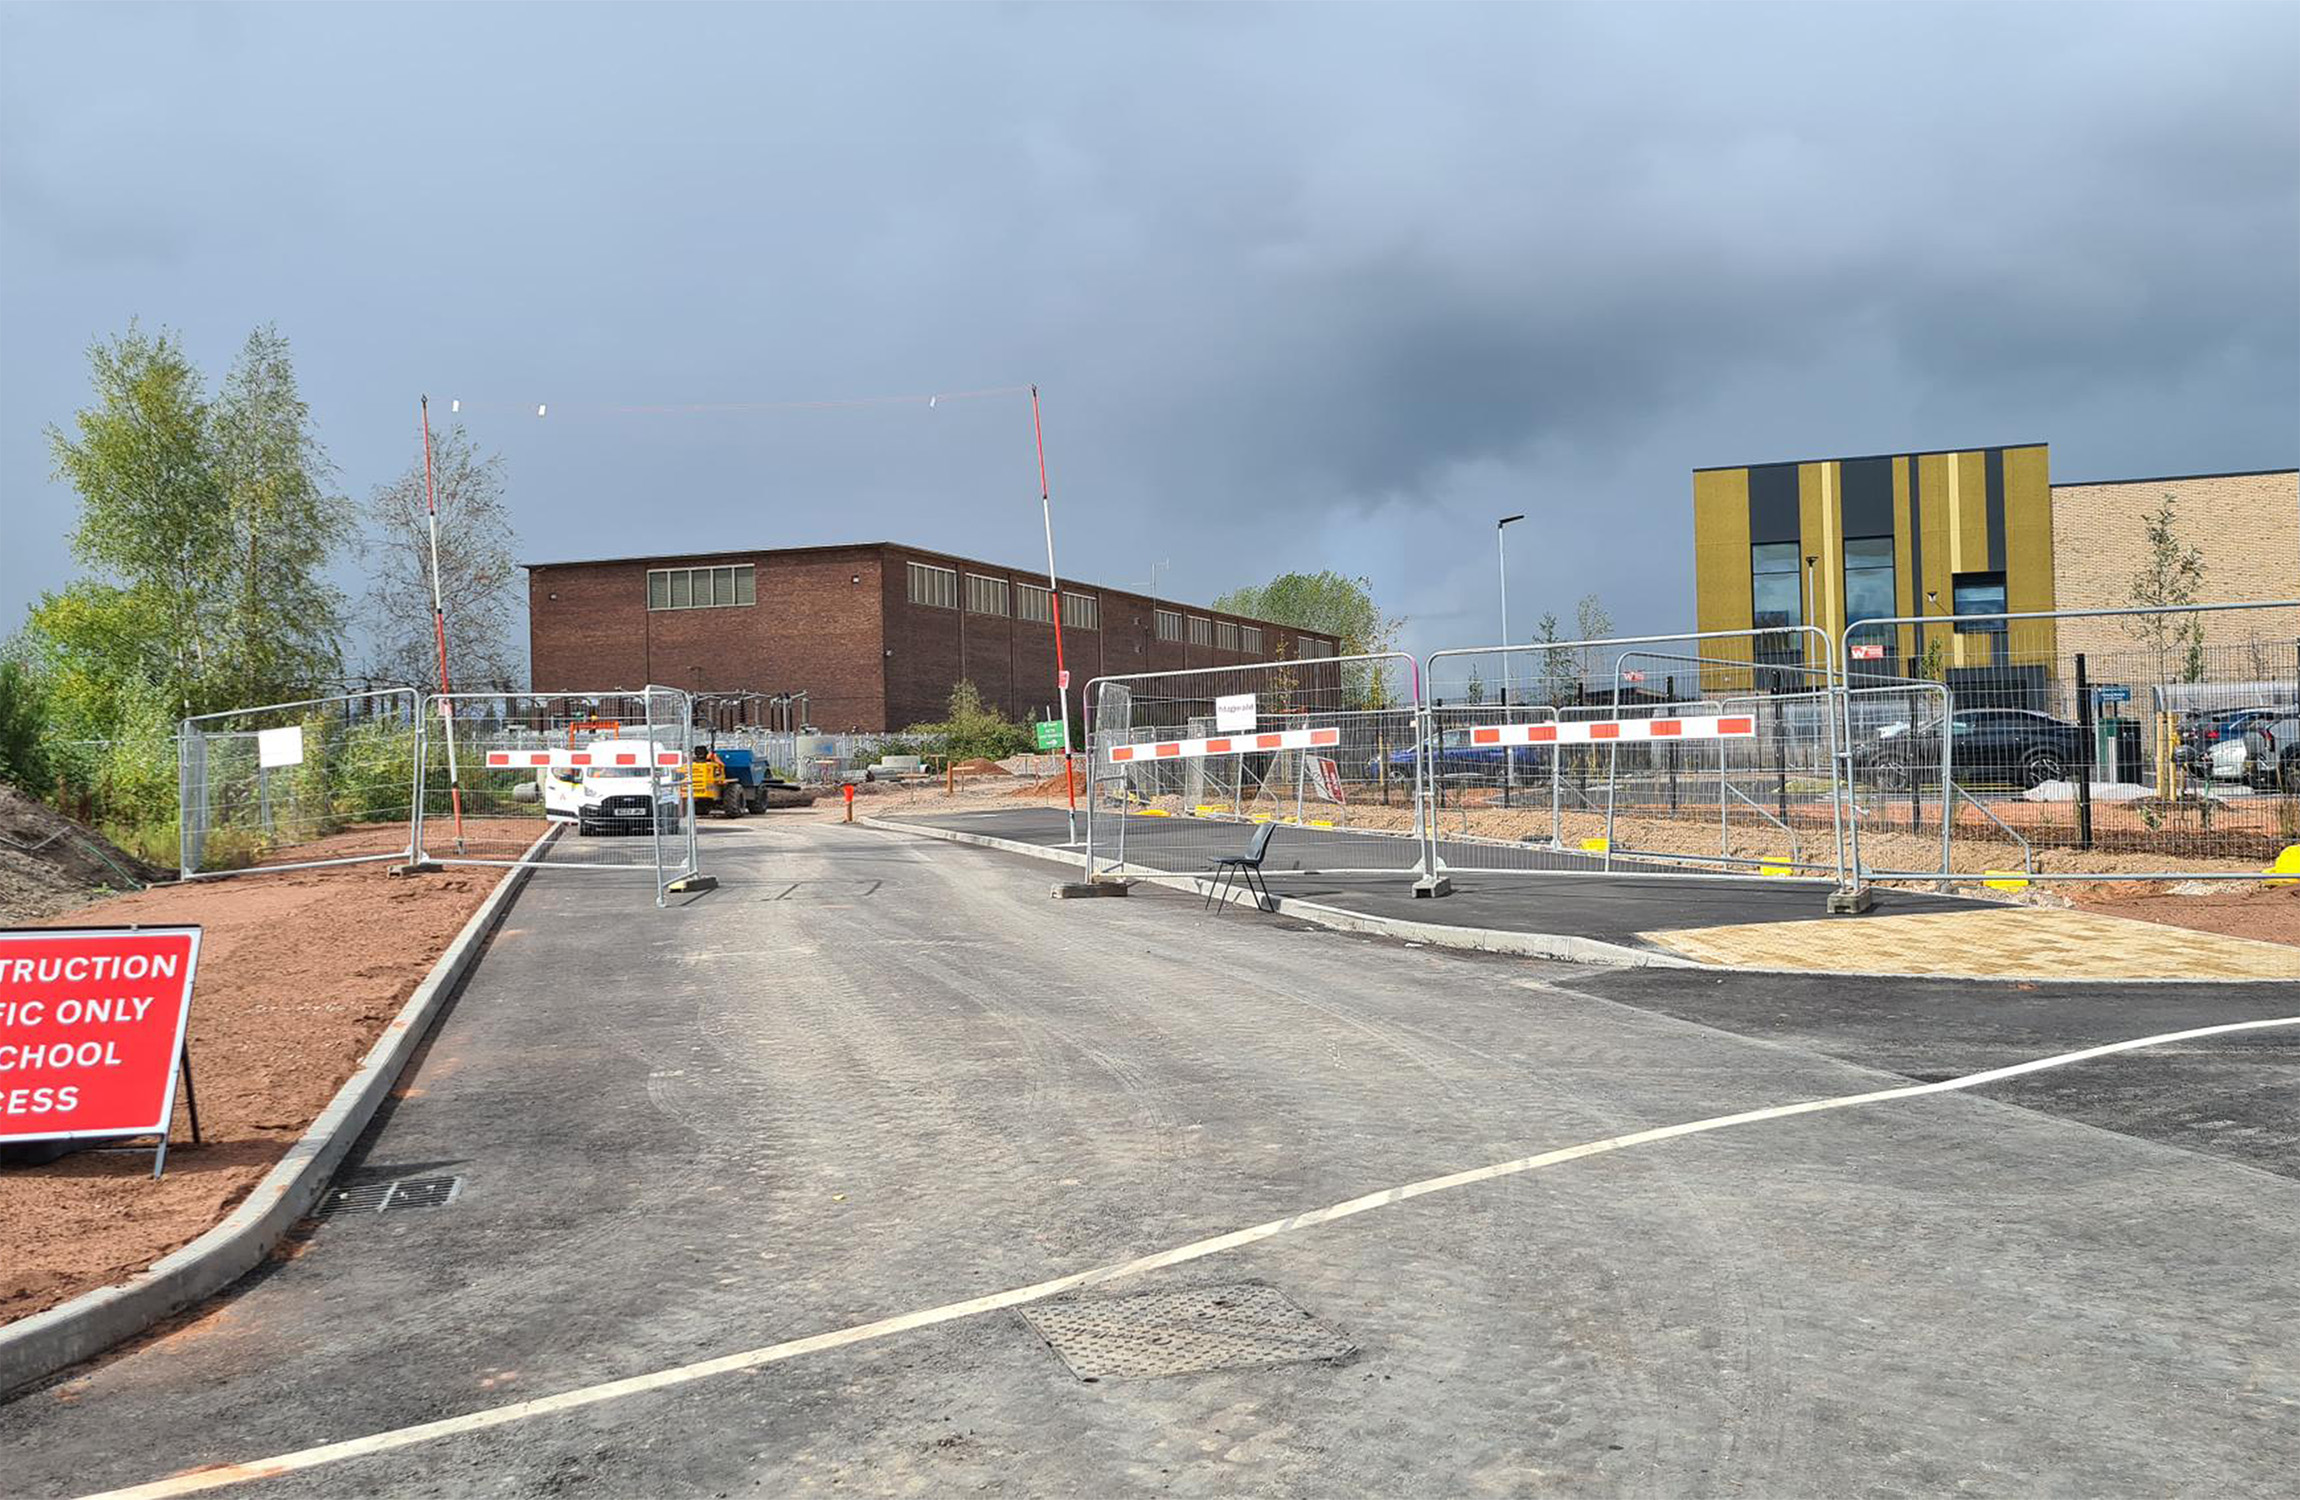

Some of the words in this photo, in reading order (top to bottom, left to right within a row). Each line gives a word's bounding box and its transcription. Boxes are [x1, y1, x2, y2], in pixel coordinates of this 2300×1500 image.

[56, 997, 155, 1025] ONLY
[0, 1041, 123, 1071] CHOOL
[0, 1086, 80, 1114] ESS
